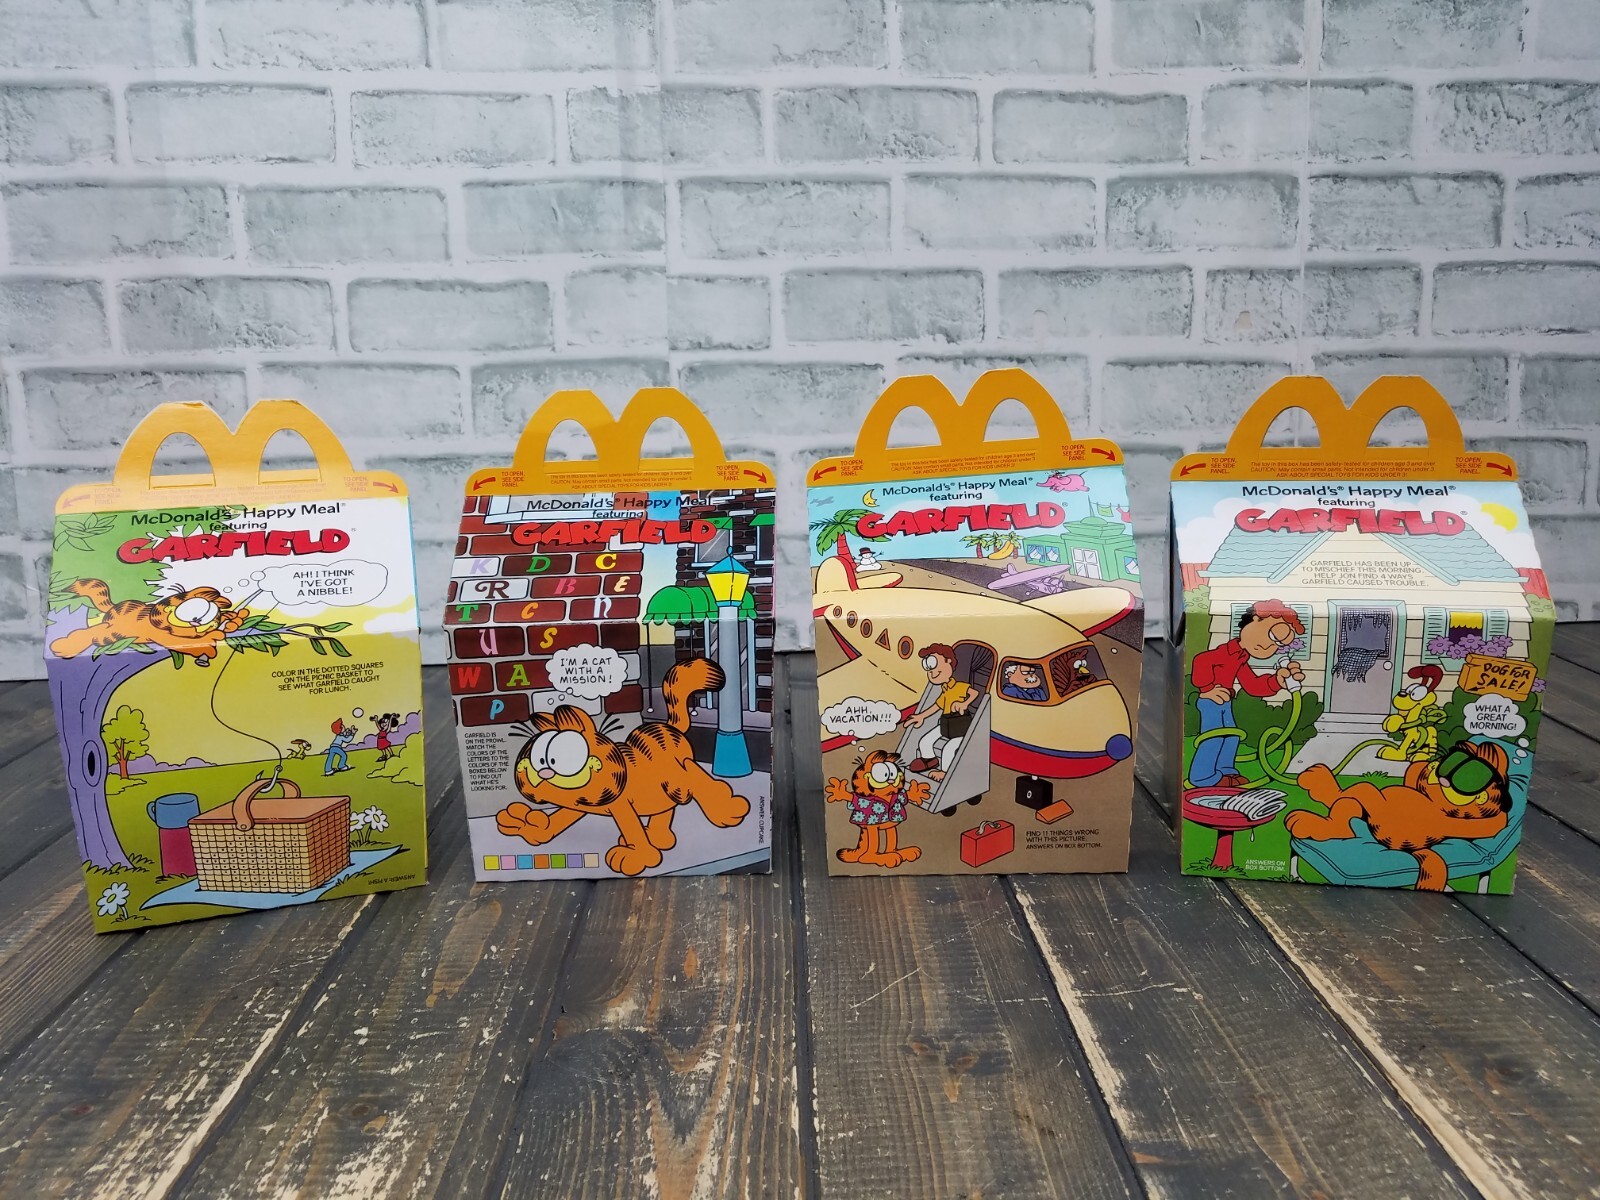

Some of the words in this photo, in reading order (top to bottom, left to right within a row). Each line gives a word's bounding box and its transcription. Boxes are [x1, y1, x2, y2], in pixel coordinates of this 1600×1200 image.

[958, 481, 996, 490] Happy
[929, 492, 983, 502] featuring
[1348, 486, 1402, 498] Happy
[624, 498, 672, 508] Happy
[1318, 498, 1376, 508] featuring
[243, 507, 296, 520] Happy
[592, 510, 644, 520] featuring
[209, 521, 268, 531] featuring
[856, 502, 1066, 539] GARFIELD
[1234, 508, 1466, 536] GARFIELD
[512, 519, 717, 547] GARFIELD
[117, 529, 350, 565] GARFIELD
[470, 559, 490, 574] K
[526, 556, 550, 572] D
[595, 554, 617, 570] C
[292, 571, 313, 580] AH!
[321, 570, 354, 578] THINK
[300, 580, 322, 588] I'VE
[324, 578, 348, 586] GOT
[475, 581, 510, 599] R
[554, 578, 577, 594] B
[614, 576, 630, 592] E
[308, 587, 353, 596] NIBBLE!
[456, 604, 478, 622] T
[520, 602, 539, 619] C
[540, 628, 558, 648] S
[560, 658, 577, 667] I'M
[592, 657, 612, 665] CAT
[272, 670, 296, 678] COLOR
[322, 665, 350, 673] DOTTED
[351, 662, 384, 671] SQUARES
[565, 666, 593, 675] WITH
[1484, 662, 1510, 676] DOG
[312, 673, 334, 681] PICNIC
[336, 670, 362, 678] BASKET
[458, 666, 481, 688] W
[506, 664, 531, 687] A
[294, 682, 314, 690] WHAT
[316, 679, 350, 687] GARFIELD
[351, 675, 380, 684] CAUGHT
[1477, 673, 1526, 692] SALE!
[490, 700, 504, 720] P
[1475, 705, 1502, 713] WHAT
[1504, 705, 1511, 713] A
[1476, 713, 1507, 721] GREAT
[1469, 722, 1517, 731] MORNING!
